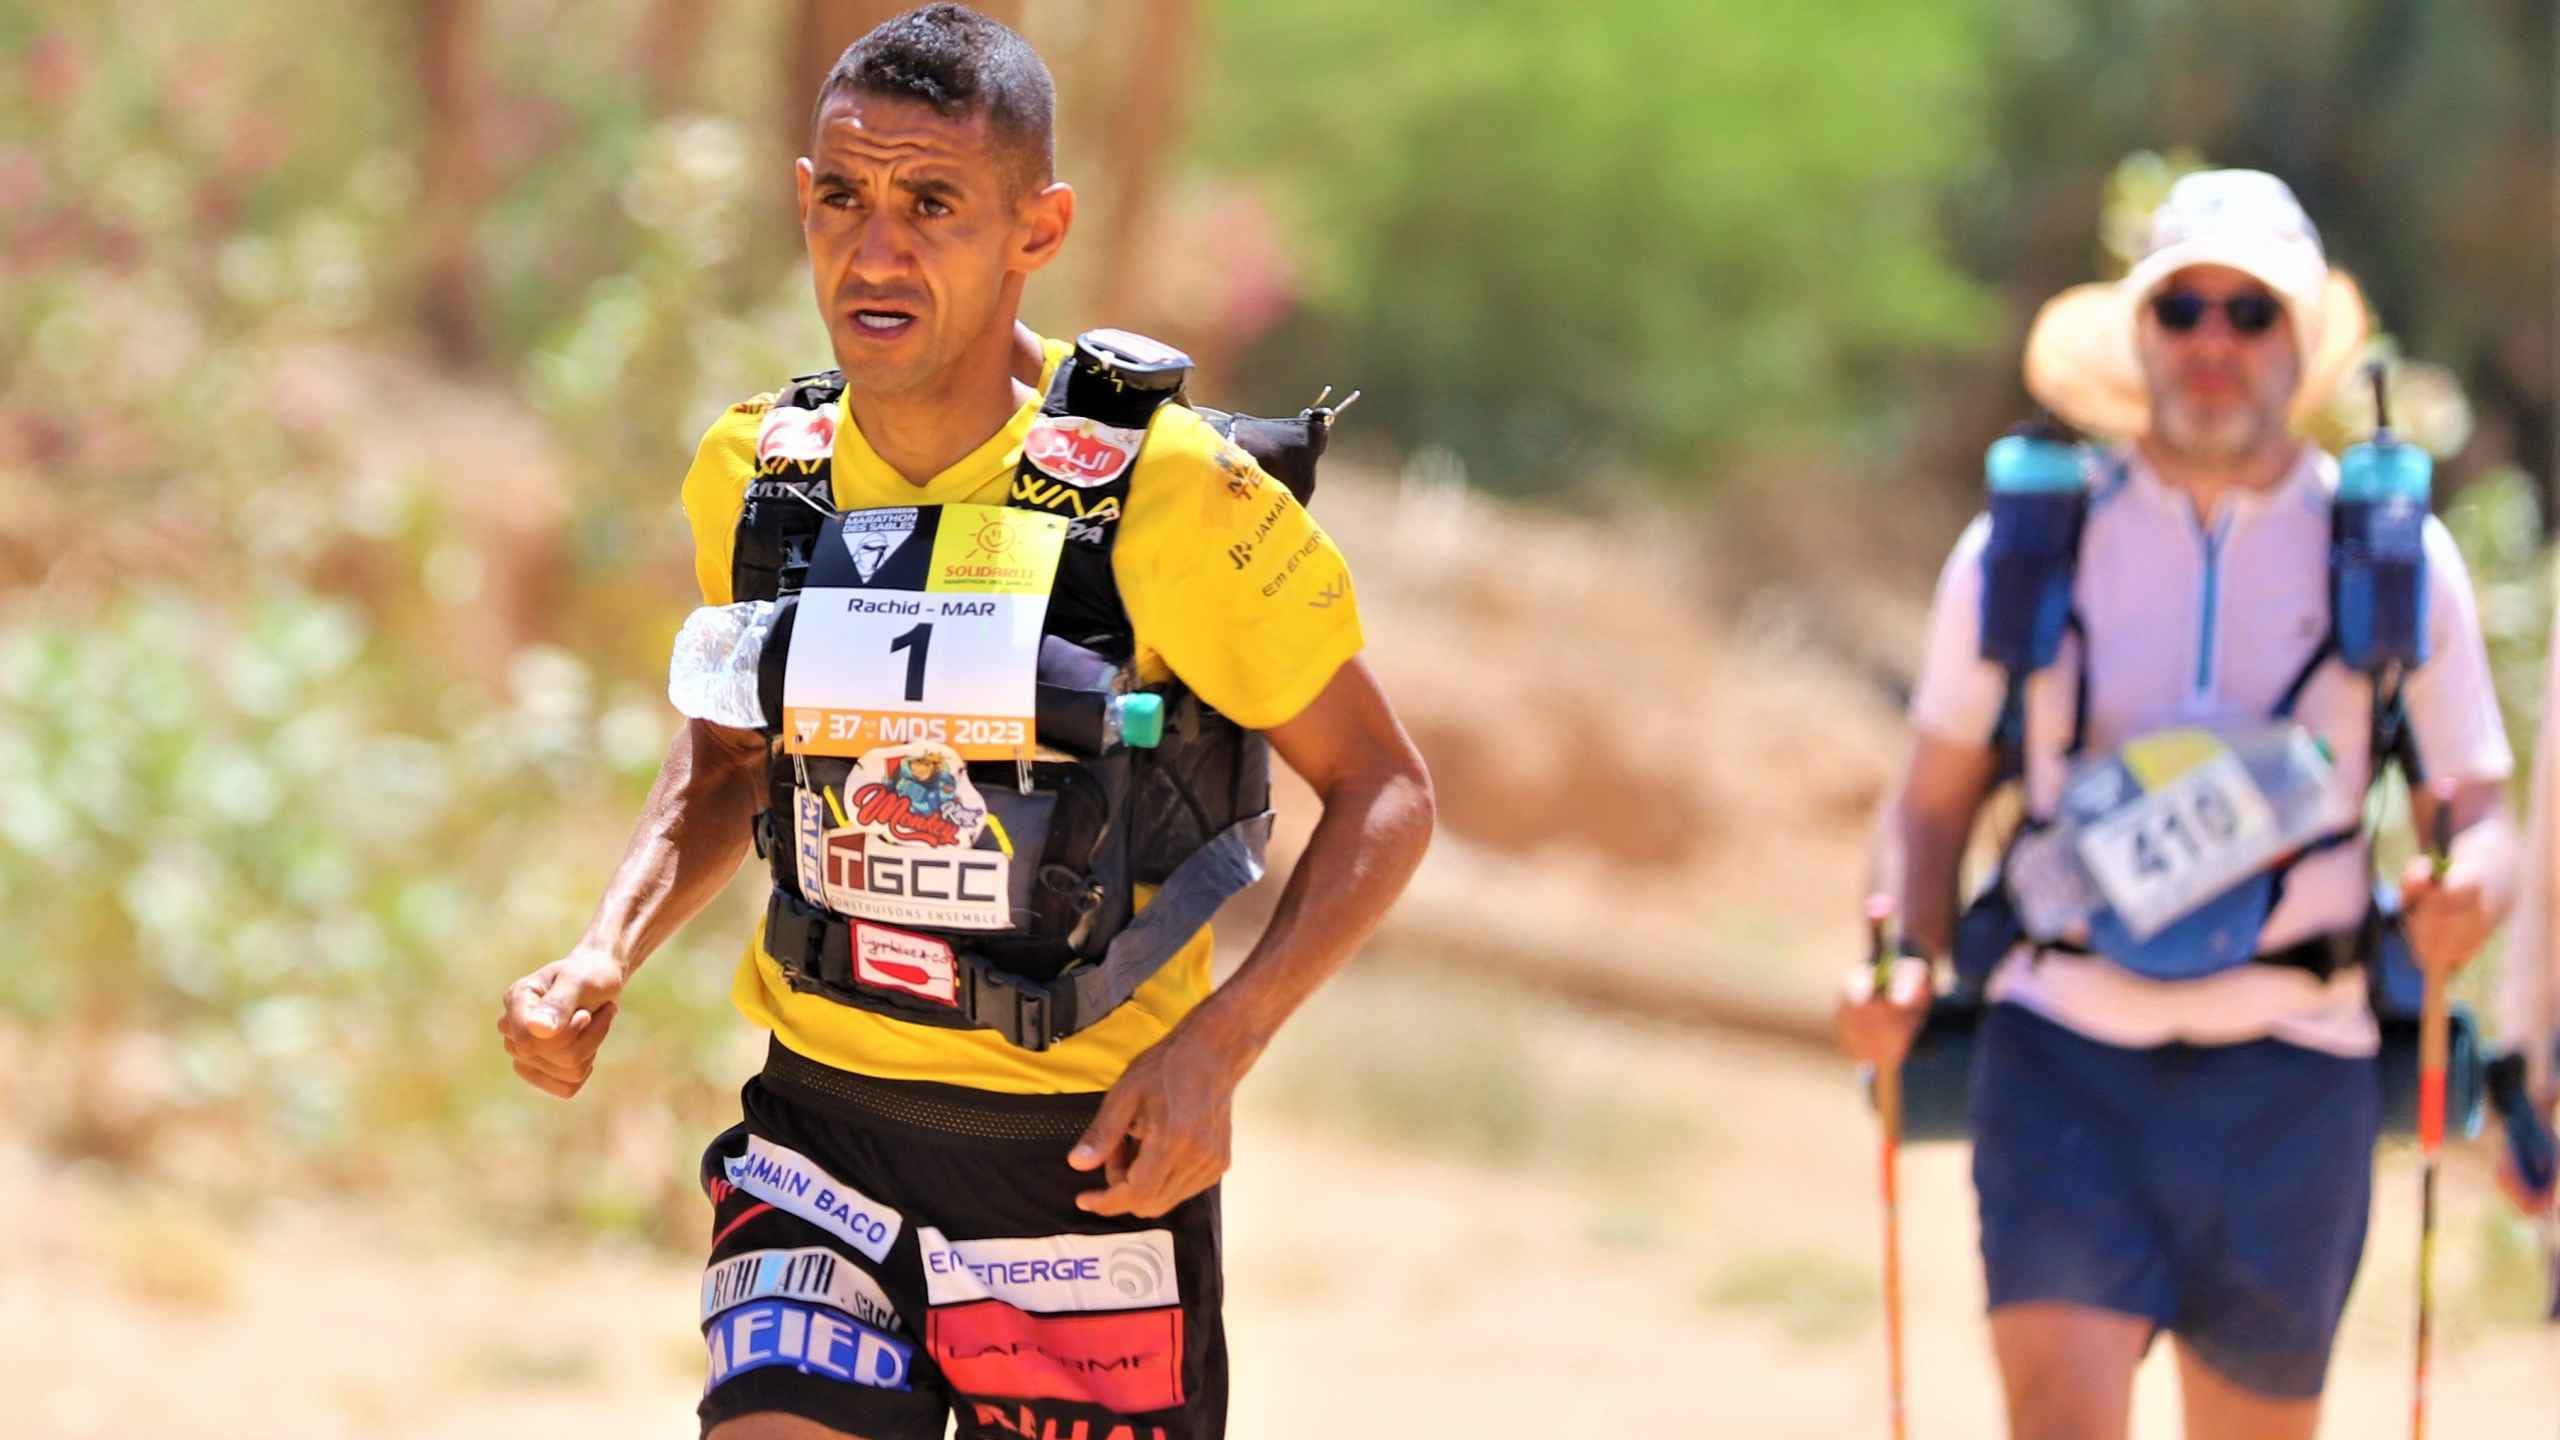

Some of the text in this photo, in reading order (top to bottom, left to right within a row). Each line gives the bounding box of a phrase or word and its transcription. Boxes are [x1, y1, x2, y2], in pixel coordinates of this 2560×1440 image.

[845, 511, 917, 525] MARATHON
[848, 598, 921, 615] Rachid
[941, 602, 995, 616] MAR
[890, 622, 933, 702] 1
[829, 714, 862, 740] 37
[880, 717, 947, 743] MDS
[954, 720, 1026, 745] 2023
[2134, 786, 2238, 878] 410
[927, 910, 998, 925] ENSEMBLE
[814, 1188, 886, 1245] BACO
